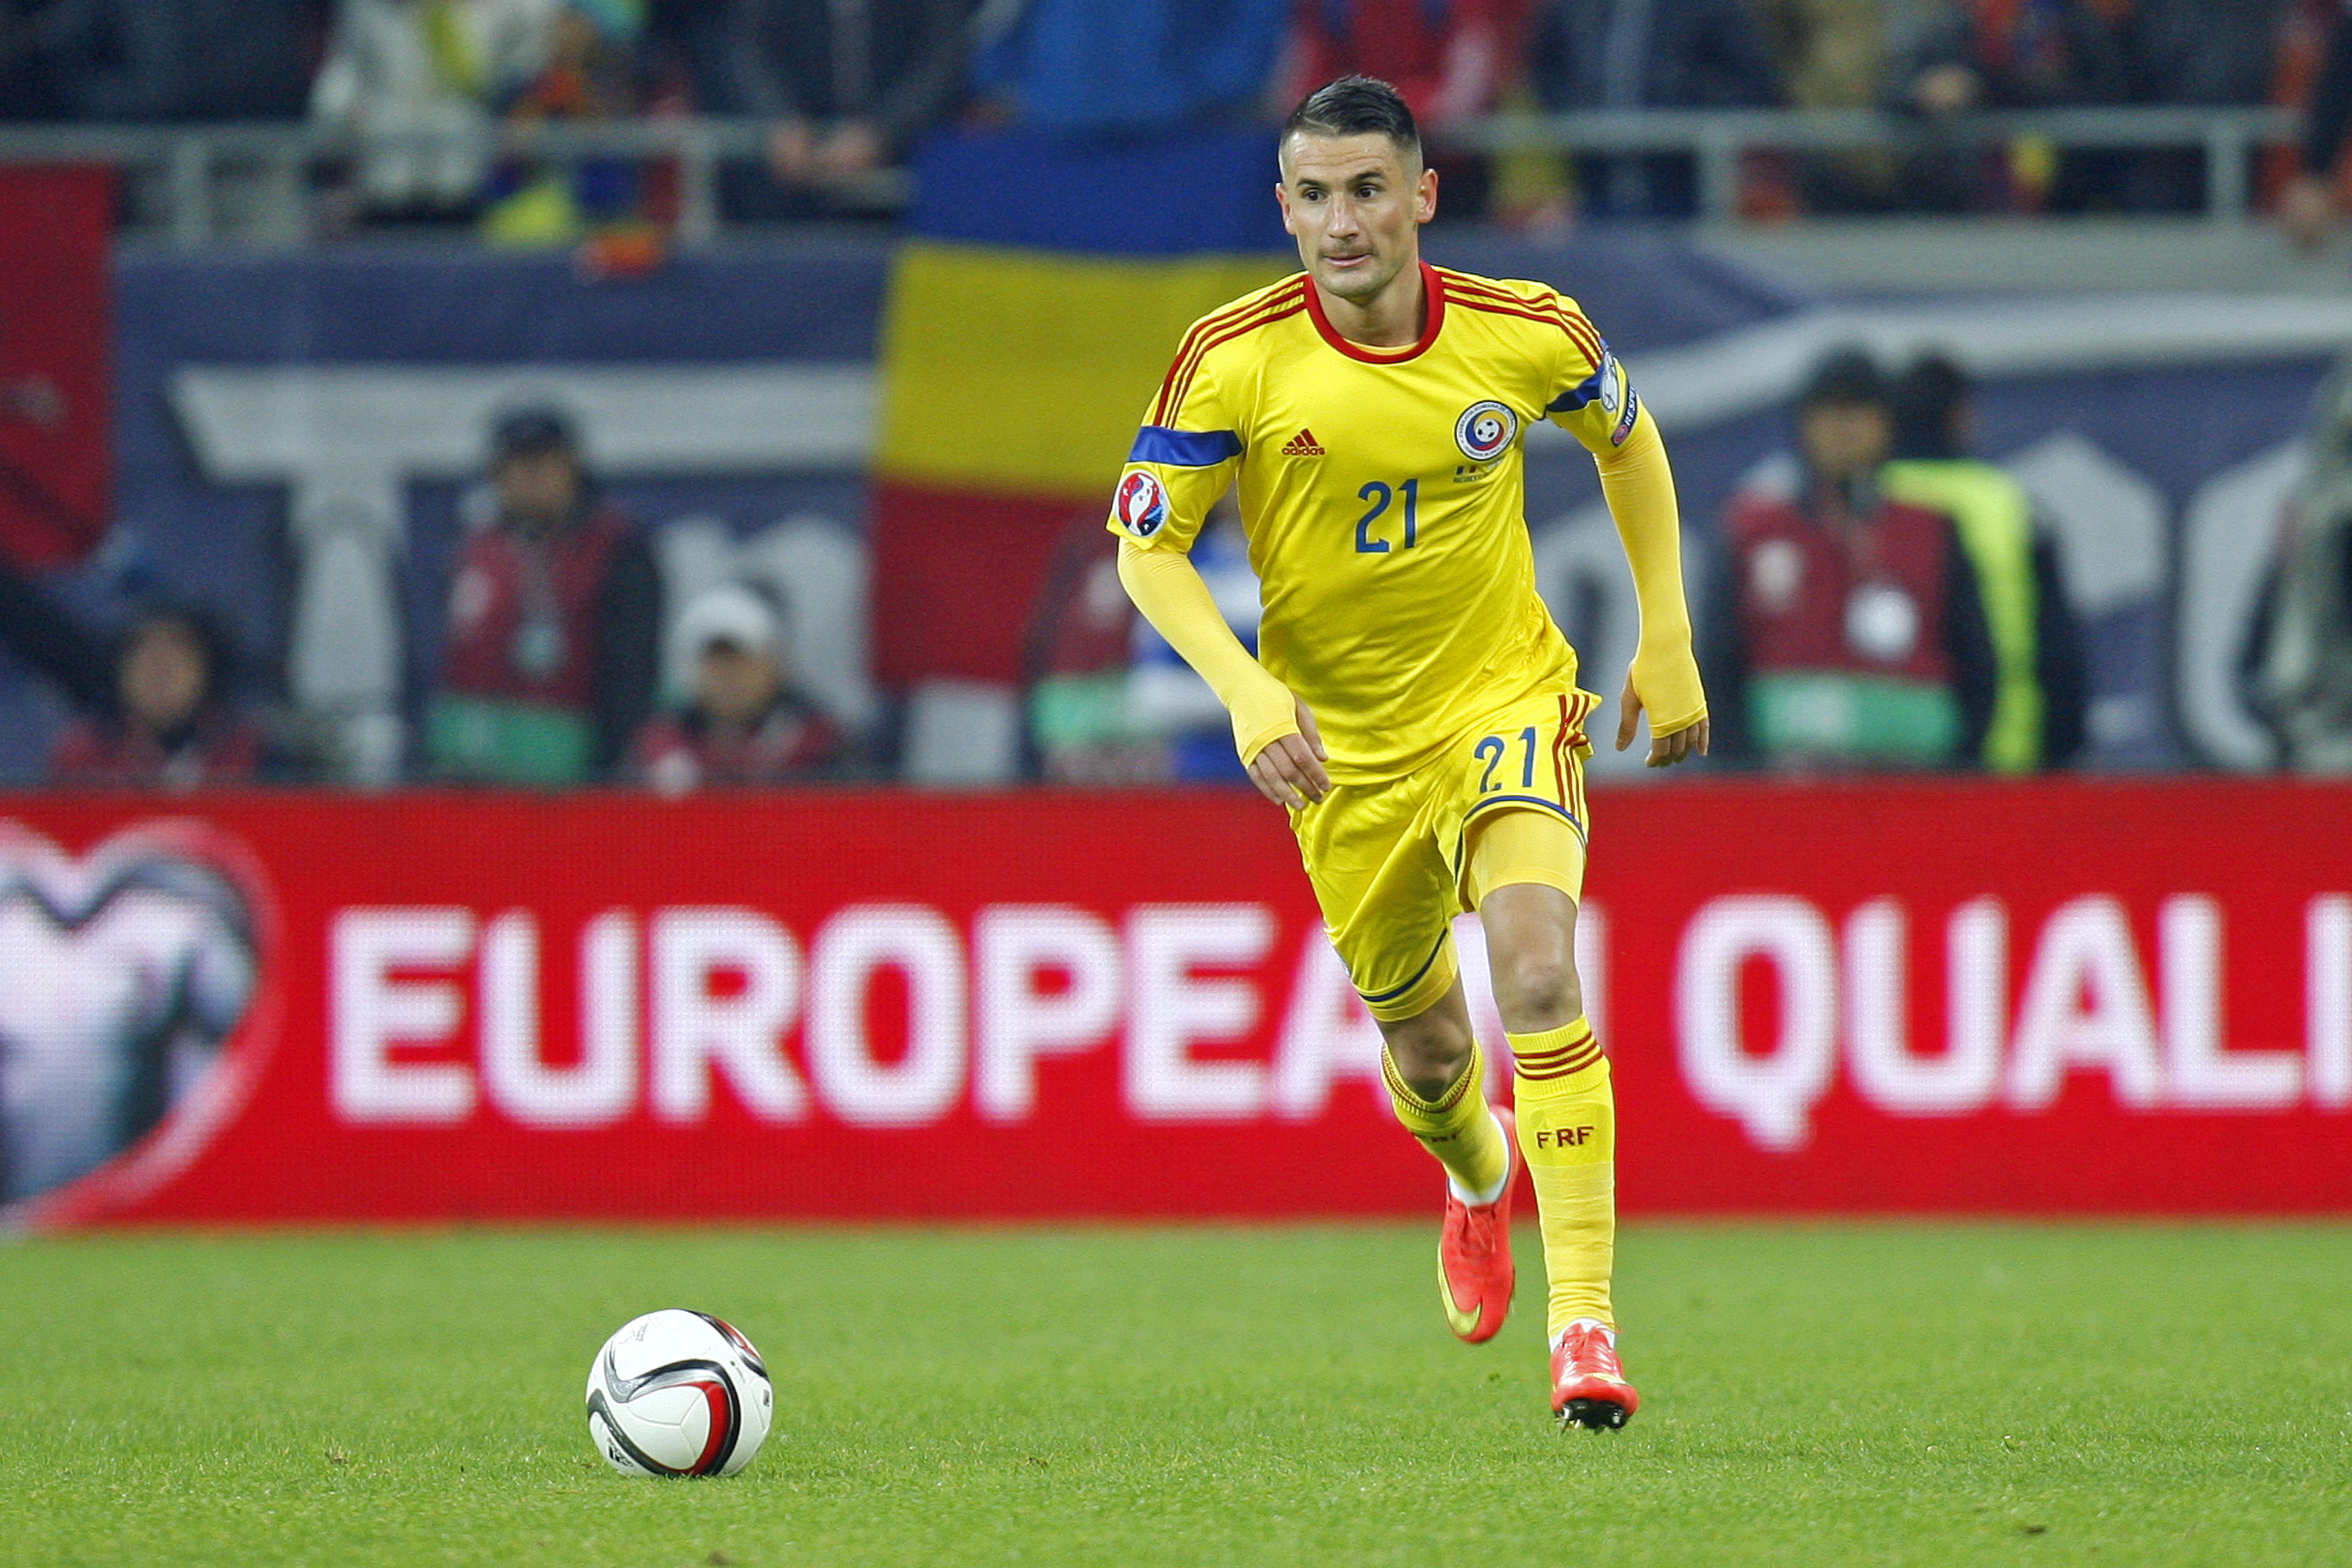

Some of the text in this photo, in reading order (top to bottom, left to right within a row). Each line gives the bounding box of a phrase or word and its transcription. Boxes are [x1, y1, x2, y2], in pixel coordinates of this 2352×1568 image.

[1281, 446, 1325, 456] adidas
[1356, 478, 1418, 553] 21
[1474, 725, 1536, 795] 21
[1672, 890, 2352, 1152] QUALI
[1536, 1126, 1594, 1149] FRF
